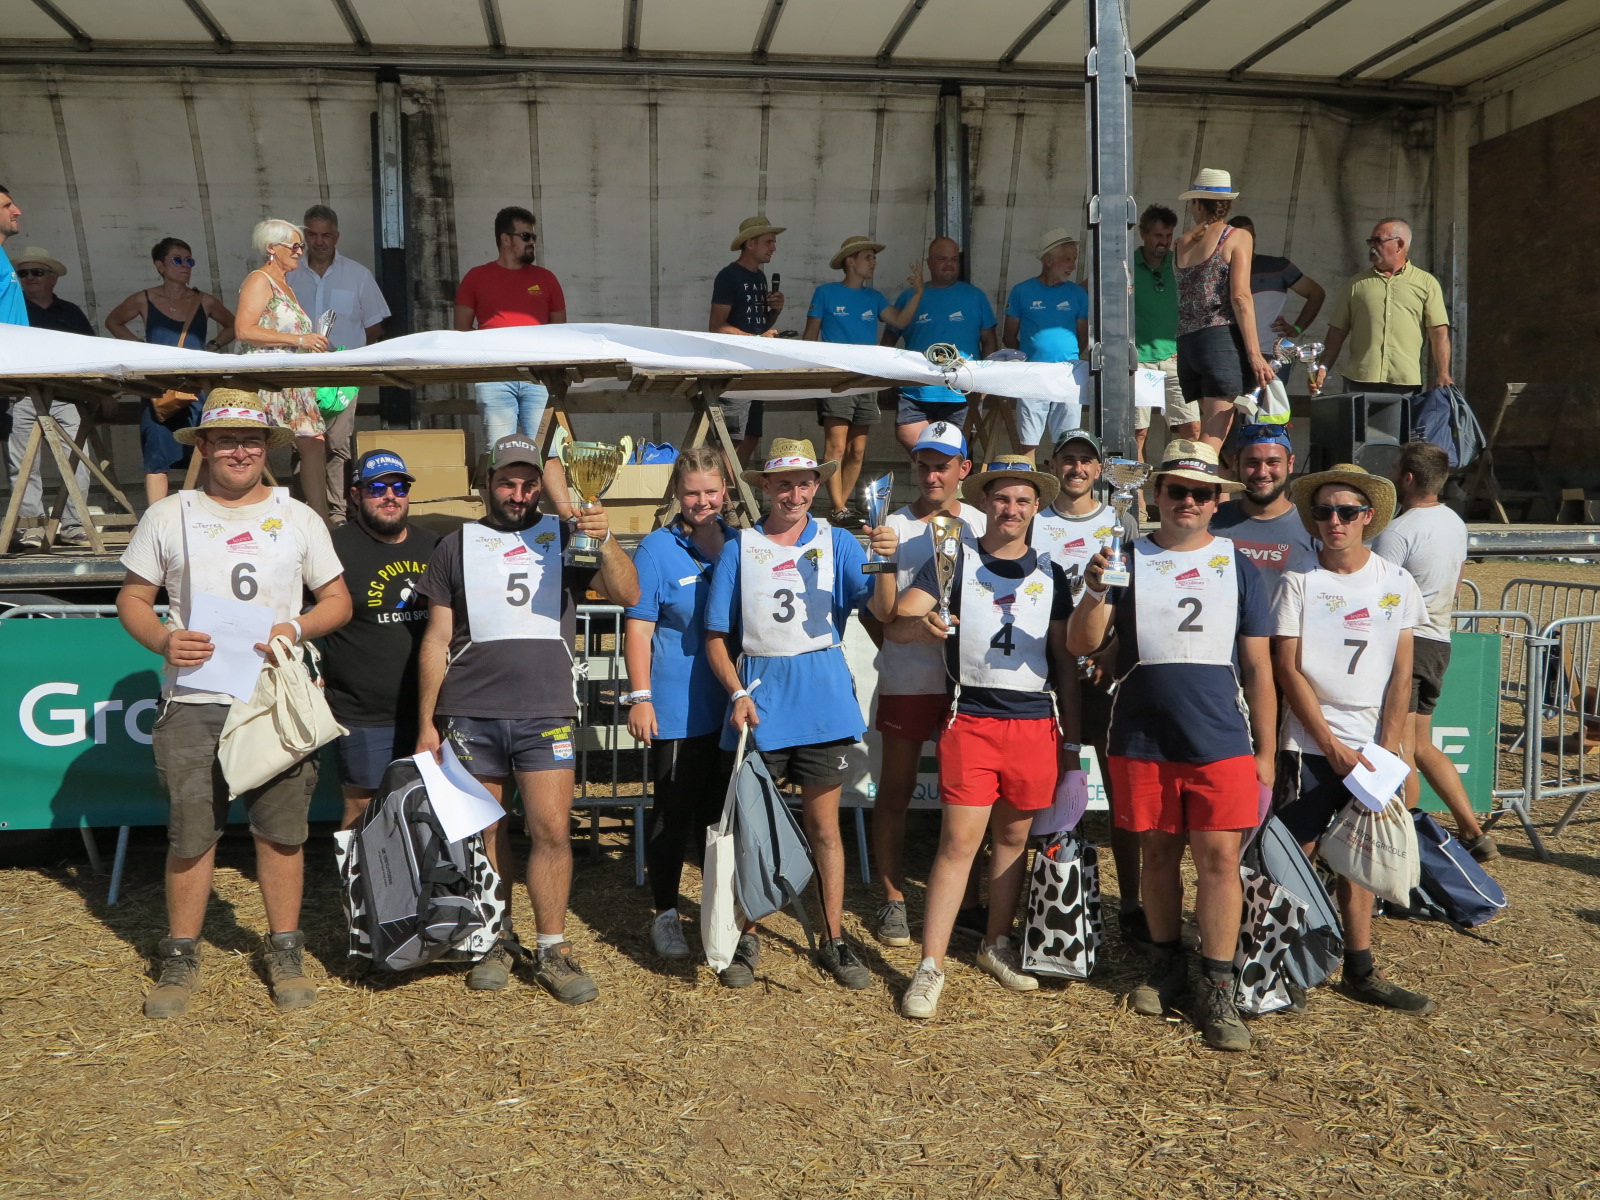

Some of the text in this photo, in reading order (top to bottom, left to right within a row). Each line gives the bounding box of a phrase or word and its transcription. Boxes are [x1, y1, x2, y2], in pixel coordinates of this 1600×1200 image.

[746, 294, 766, 302] PLA
[499, 440, 537, 452] FENDT
[1239, 547, 1283, 562] evi's
[231, 562, 258, 601] 6
[367, 560, 427, 607] USC POUYAS
[506, 572, 531, 607] 5
[377, 608, 429, 623] LE COQ SPO
[772, 588, 796, 623] 3
[1178, 597, 1204, 632] 2
[990, 622, 1016, 656] 4
[1344, 638, 1368, 675] 7
[19, 682, 158, 747] Gro
[1431, 726, 1471, 774] E
[1371, 840, 1407, 859] AGRICOLE
